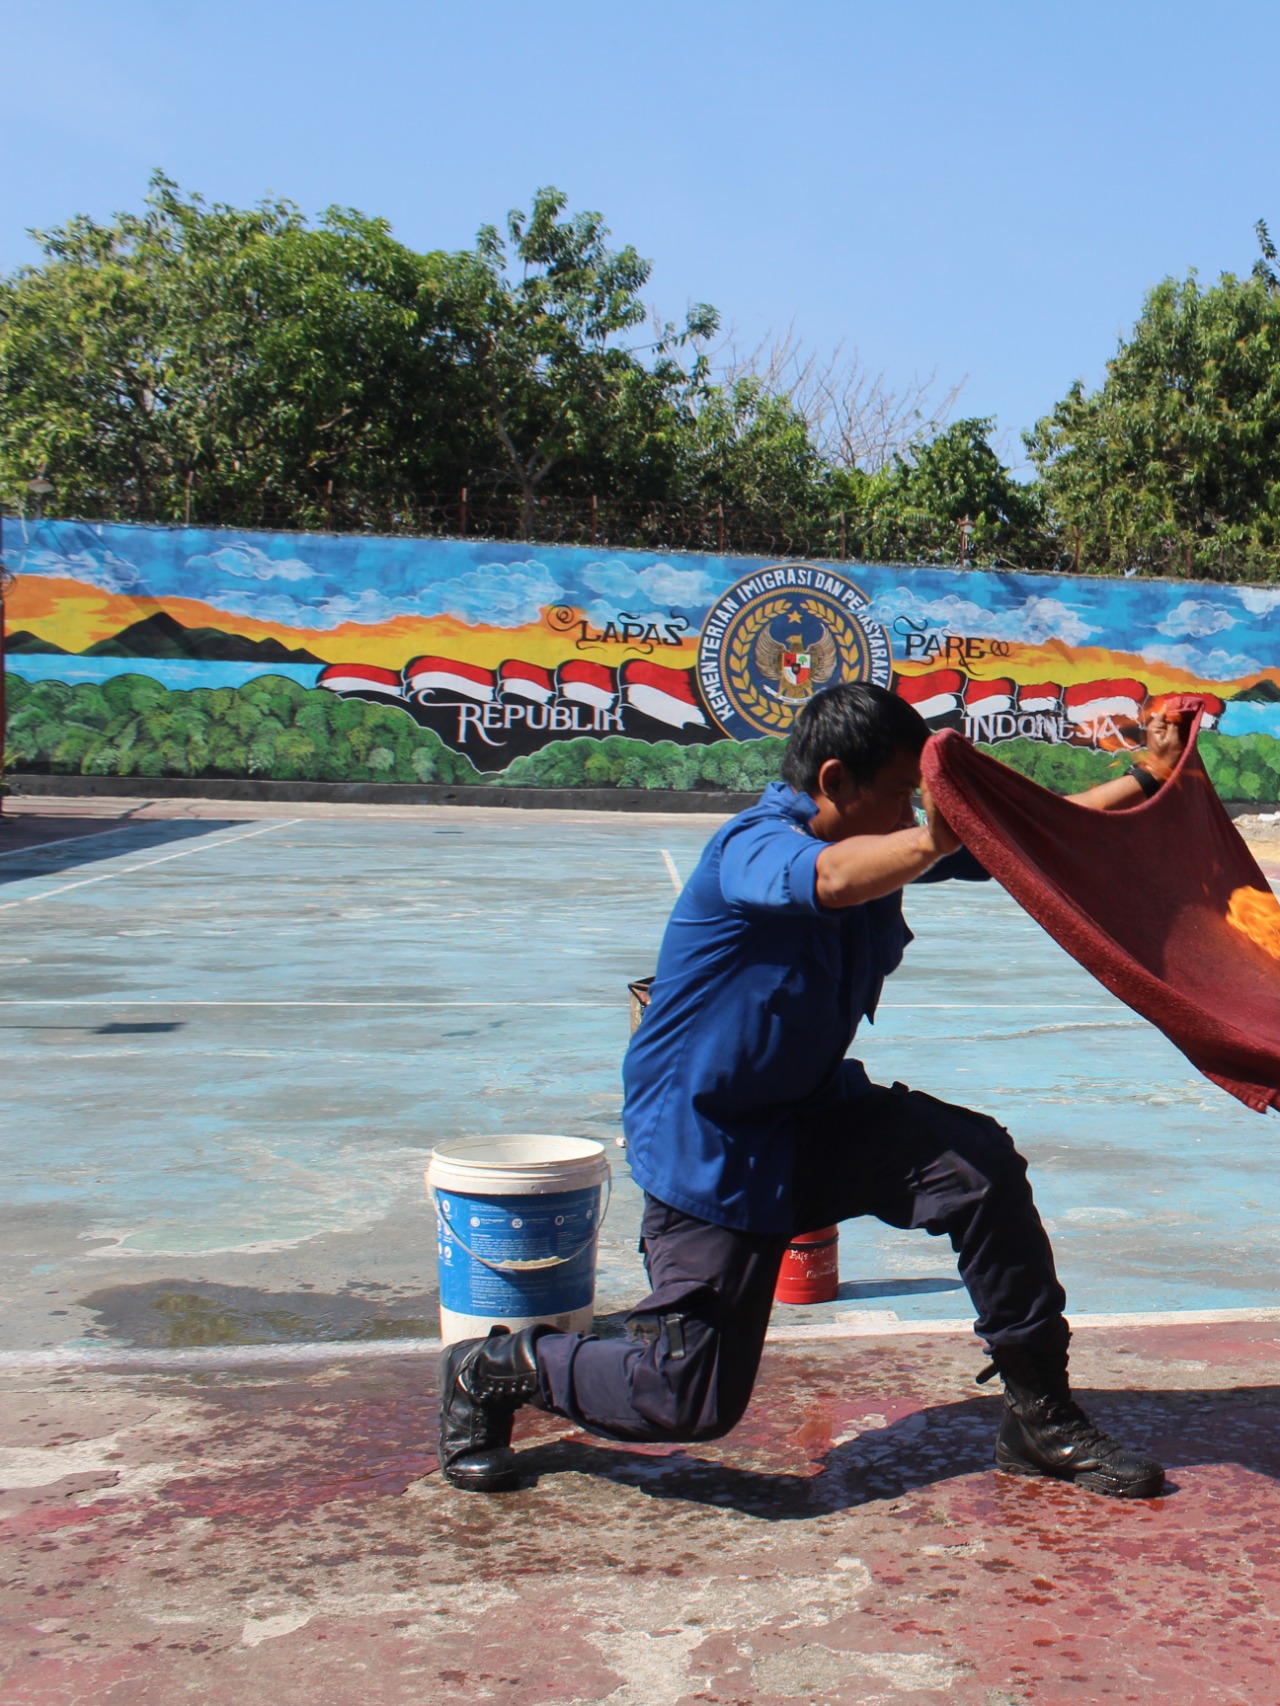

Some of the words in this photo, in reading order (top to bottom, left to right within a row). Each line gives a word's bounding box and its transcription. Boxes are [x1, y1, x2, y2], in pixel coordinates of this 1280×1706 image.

[566, 611, 690, 654] LAPAS
[700, 597, 740, 722] KEMENTERIAN
[736, 568, 812, 602] IMIGRASI
[814, 572, 845, 598] DAN
[419, 697, 626, 747] REPUBLIK
[963, 714, 1141, 750] INDONESIA
